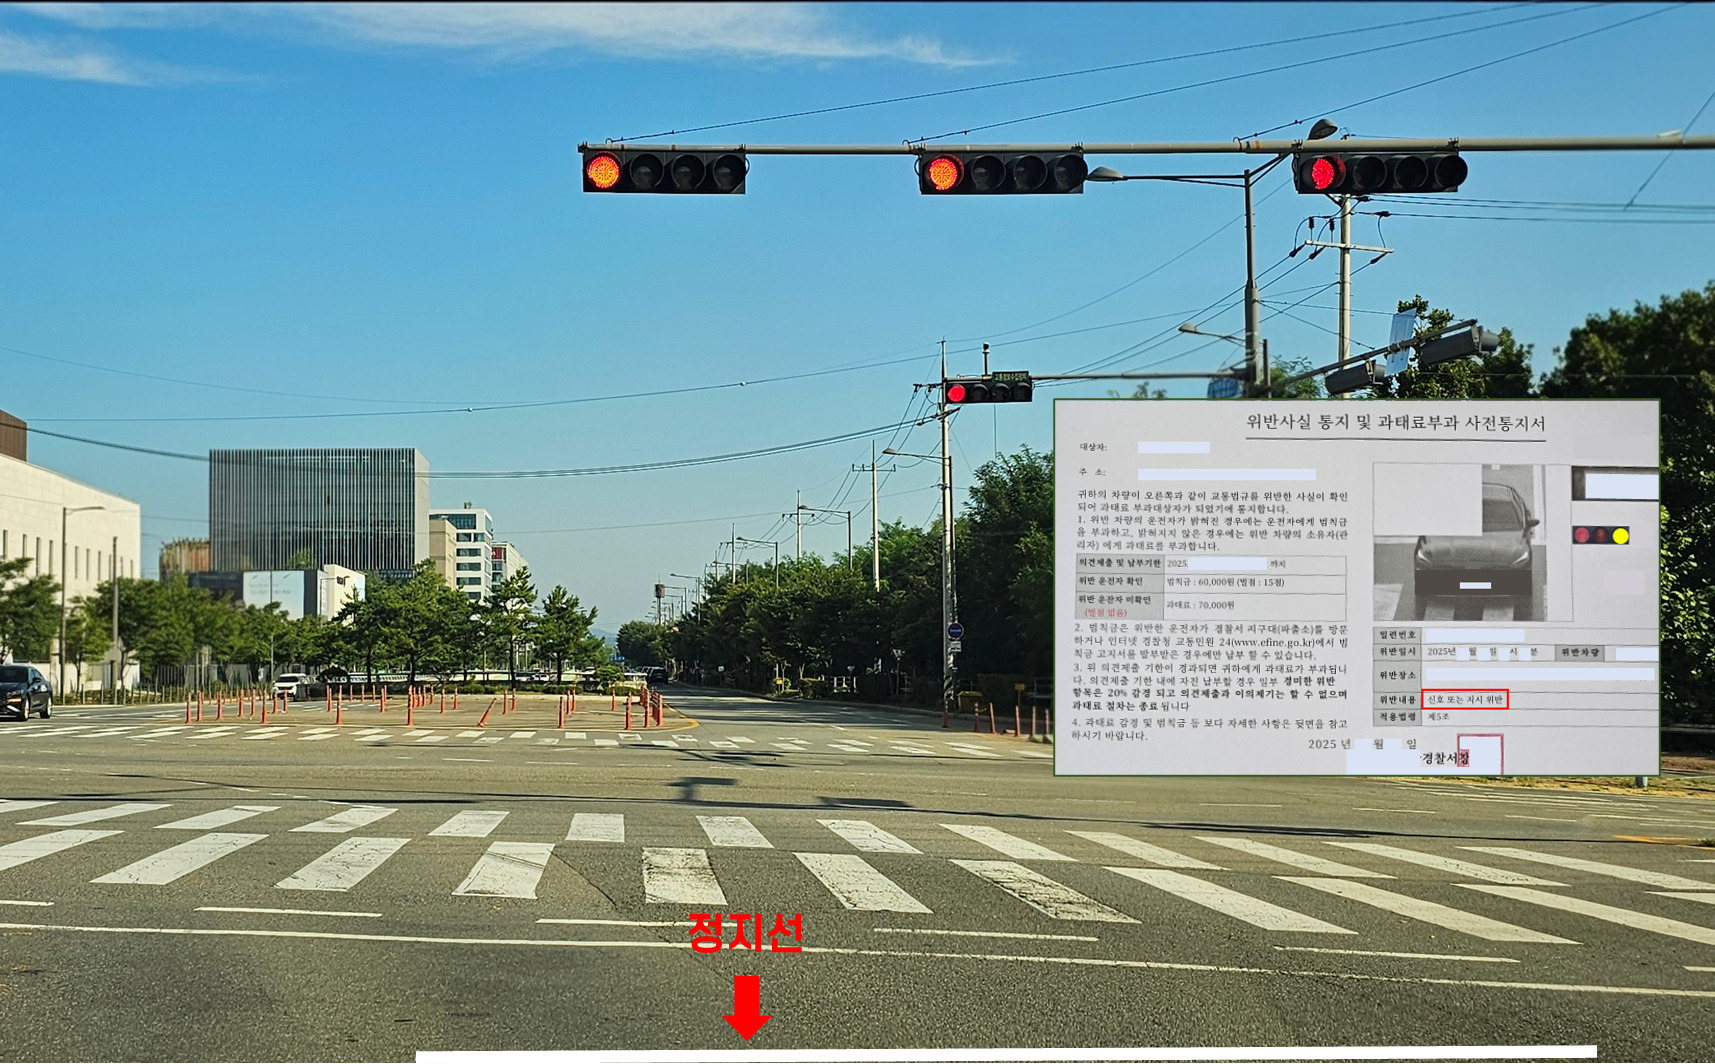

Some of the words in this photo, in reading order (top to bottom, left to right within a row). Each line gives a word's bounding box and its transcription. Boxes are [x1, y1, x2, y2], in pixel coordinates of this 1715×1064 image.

[1247, 414, 1310, 430] 위반사실
[1318, 414, 1348, 430] 통지
[1357, 414, 1370, 430] 및
[1378, 414, 1459, 431] 과태료부과
[1465, 415, 1544, 432] 사전통지서
[1080, 443, 1107, 451] 대상자:
[1078, 490, 1106, 499] 귀하의
[1112, 490, 1139, 500] 차량이
[1145, 491, 1183, 500] 오른쪽과
[1188, 491, 1206, 501] 같이
[1211, 492, 1259, 501] 교통법규를
[1264, 492, 1292, 501] 위반한
[1296, 492, 1324, 502] 사실이
[1329, 492, 1347, 502] 확인
[1078, 502, 1096, 512] 되어
[1101, 502, 1129, 512] 과태료
[1134, 503, 1191, 513] 부과대상자가
[1196, 504, 1233, 514] 되었기에
[1237, 504, 1288, 514] 통지합니다.
[1090, 515, 1109, 524] 위반
[1114, 516, 1142, 525] 차량의
[1147, 516, 1186, 526] 운전자가
[1191, 517, 1218, 526] 밝혀진
[1225, 517, 1262, 526] 경우에는
[1267, 517, 1314, 526] 운전자에게
[1320, 518, 1347, 527] 범칙금
[1077, 527, 1086, 537] 을
[1091, 527, 1133, 538] 부과하고,
[1138, 528, 1176, 538] 밝혀지지
[1182, 529, 1201, 539] 않은
[1206, 529, 1244, 539] 경우에는
[1249, 529, 1268, 539] 위반
[1273, 529, 1301, 539] 차량의
[1307, 530, 1348, 540] 소유자(관
[1077, 540, 1099, 551] 리자)
[1103, 541, 1121, 550] 에게
[1125, 541, 1164, 551] 과태료를
[1169, 542, 1219, 551] 부과합니다.
[1080, 558, 1113, 567] 의견제출
[1116, 558, 1124, 567] 및
[1128, 559, 1161, 568] 납부기한
[1270, 560, 1285, 568] 까지
[1079, 576, 1095, 585] 위반
[1099, 577, 1123, 585] 운전자
[1127, 577, 1142, 586] 확인
[1167, 577, 1191, 586] 범칙금
[1198, 578, 1234, 586] 60,000원
[1237, 578, 1255, 587] (벌점
[1265, 578, 1284, 587] 15점)
[1079, 595, 1095, 603] 위반
[1126, 596, 1151, 604] 미확인
[1167, 601, 1191, 609] 과태료
[1199, 601, 1234, 610] 70,000원
[1085, 608, 1104, 617] (벌점
[1108, 608, 1127, 617] 없음)
[1075, 623, 1083, 632] 2.
[1089, 623, 1129, 633] 범칙금은
[1134, 623, 1163, 634] 위반한
[1169, 624, 1209, 634] 운전자가
[1215, 624, 1243, 634] 경찰서
[1248, 624, 1323, 635] 지구대(파출소)를
[1329, 625, 1348, 635] 방문
[1380, 630, 1416, 639] 일련번호
[1074, 636, 1103, 646] 하거나
[1108, 636, 1137, 646] 인터넷
[1143, 636, 1170, 647] 경찰청
[1176, 637, 1214, 647] 교통민원
[1340, 638, 1347, 648] 범
[1074, 648, 1093, 659] 칙금
[1097, 649, 1136, 660] 고지서를
[1140, 649, 1179, 660] 발부받은
[1183, 650, 1221, 660] 경우에만
[1226, 650, 1244, 660] 납부
[1248, 650, 1257, 661] 할
[1261, 651, 1271, 660] 수
[1274, 650, 1316, 661] 있습니다.
[1380, 647, 1415, 656] 위반일시
[1428, 647, 1456, 656] 2025년
[1469, 647, 1476, 656] 월
[1490, 647, 1496, 656] 일
[1531, 648, 1538, 656] 분
[1562, 648, 1599, 657] 위반차량
[1074, 663, 1082, 672] 3.
[1087, 663, 1095, 672] 위
[1101, 663, 1140, 673] 의견제출
[1145, 663, 1173, 673] 기한이
[1179, 664, 1216, 673] 경과되면
[1222, 664, 1260, 674] 귀하에게
[1265, 664, 1304, 674] 과태료가
[1308, 665, 1346, 674] 부과됩니
[1380, 671, 1416, 680] 위반장소
[1073, 675, 1085, 685] 다.
[1090, 676, 1129, 686] 의견제출
[1134, 676, 1153, 686] 기한
[1157, 676, 1175, 686] 내에
[1180, 676, 1198, 687] 자진
[1203, 677, 1232, 686] 납부할
[1237, 677, 1255, 687] 경우
[1260, 677, 1278, 687] 일부
[1284, 676, 1312, 686] 경미한
[1316, 676, 1335, 686] 위반
[1073, 688, 1103, 697] 항목은
[1108, 689, 1127, 697] 20%
[1132, 688, 1150, 698] 감경
[1156, 688, 1176, 698] 되고
[1181, 689, 1230, 699] 의견제출과
[1235, 689, 1285, 699] 이의제기는
[1290, 690, 1299, 699] 할
[1304, 690, 1313, 699] 수
[1319, 690, 1347, 699] 없으며
[1380, 695, 1416, 704] 위반내용
[1428, 695, 1444, 704] 신호
[1447, 696, 1463, 704] 또는
[1467, 695, 1482, 704] 지시
[1486, 695, 1503, 704] 위반
[1073, 701, 1102, 710] 과태료
[1107, 701, 1135, 711] 절차는
[1139, 702, 1158, 711] 종료
[1161, 701, 1189, 711] 됩니다
[1380, 712, 1416, 721] 적용법령
[1428, 712, 1449, 721] 제5조
[1072, 718, 1081, 726] 4.
[1085, 718, 1114, 727] 과태료
[1119, 718, 1138, 728] 감경
[1143, 718, 1152, 728] 및
[1157, 718, 1186, 728] 범칙금
[1190, 718, 1200, 728] 등
[1204, 719, 1223, 728] 보다
[1228, 719, 1257, 728] 자세한
[1262, 719, 1290, 729] 사항은
[1295, 719, 1324, 729] 뒷면을
[1329, 719, 1347, 729] 참고
[1072, 730, 1101, 741] 하시기
[1105, 731, 1148, 741] 바랍니다.
[1309, 739, 1336, 749] 2025
[1341, 739, 1350, 750] 년
[1374, 739, 1383, 749] 월
[1407, 739, 1416, 749] 일
